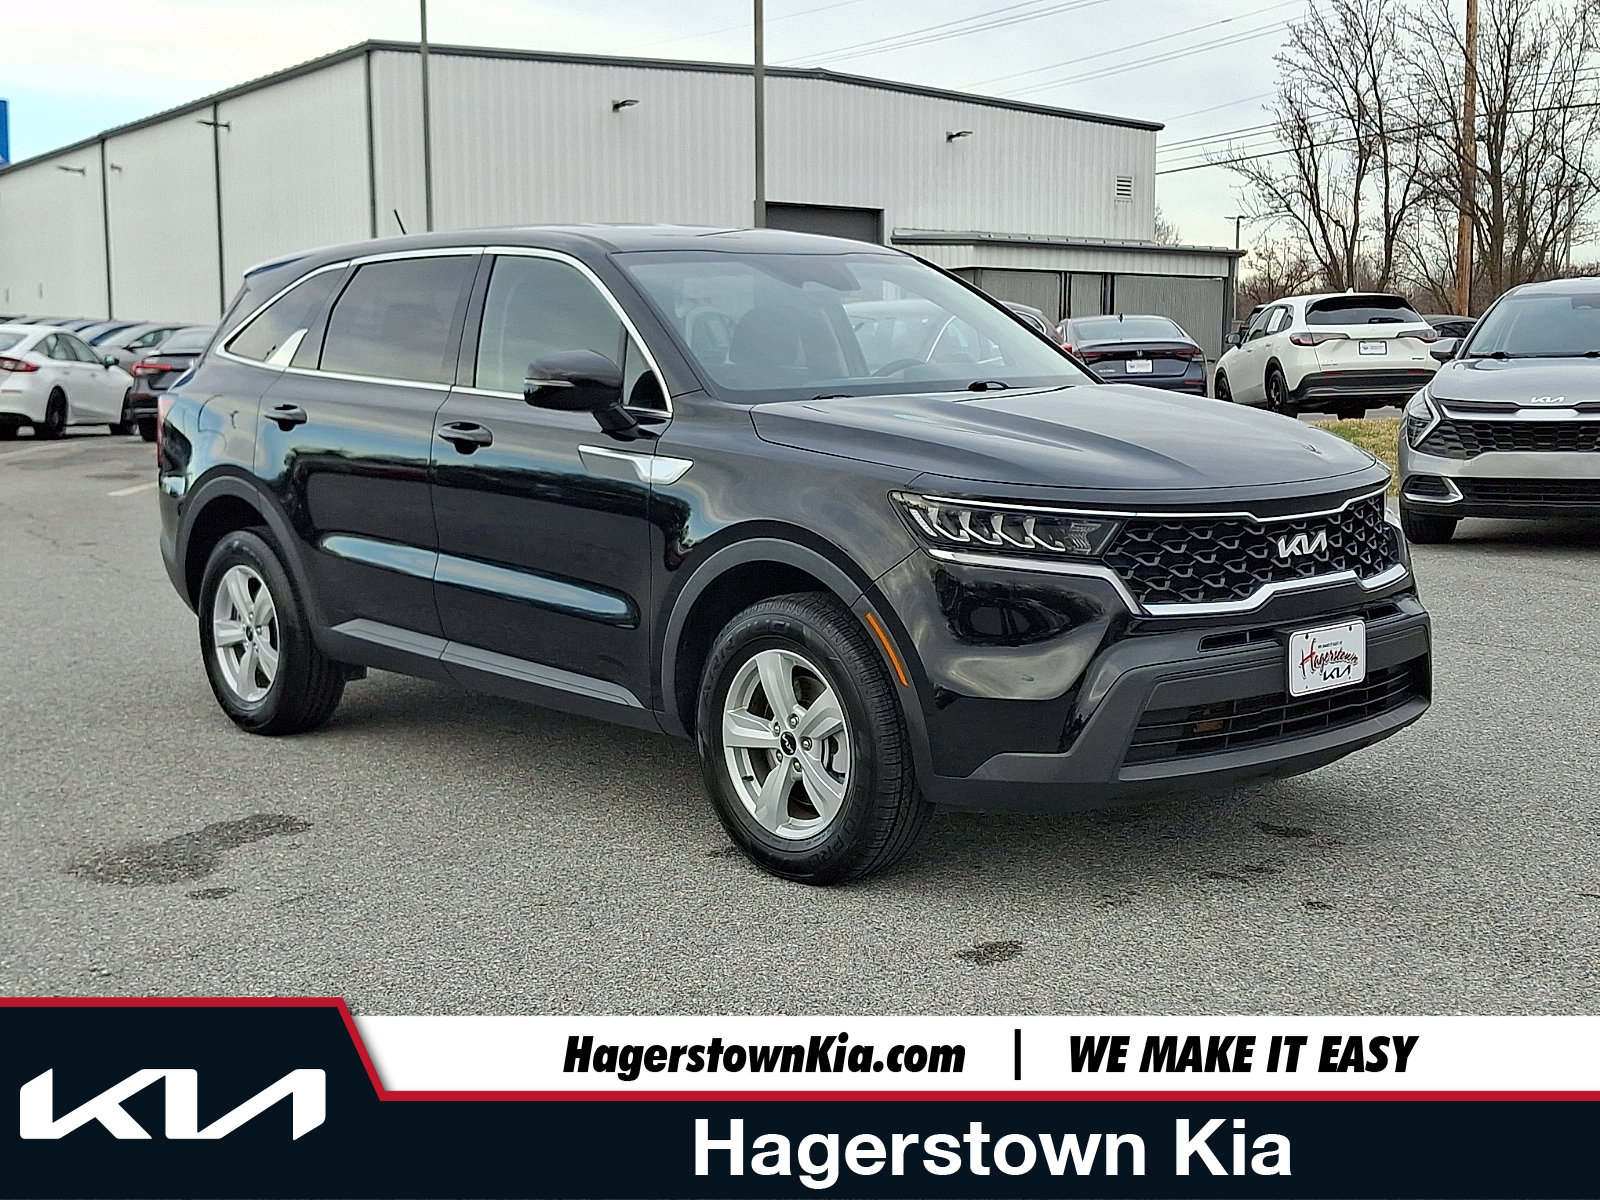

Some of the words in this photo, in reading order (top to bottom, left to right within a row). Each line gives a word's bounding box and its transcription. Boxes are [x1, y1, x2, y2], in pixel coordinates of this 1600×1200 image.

[1278, 531, 1327, 558] KIA
[1298, 638, 1358, 680] Hagerstown
[1322, 664, 1351, 681] KIA
